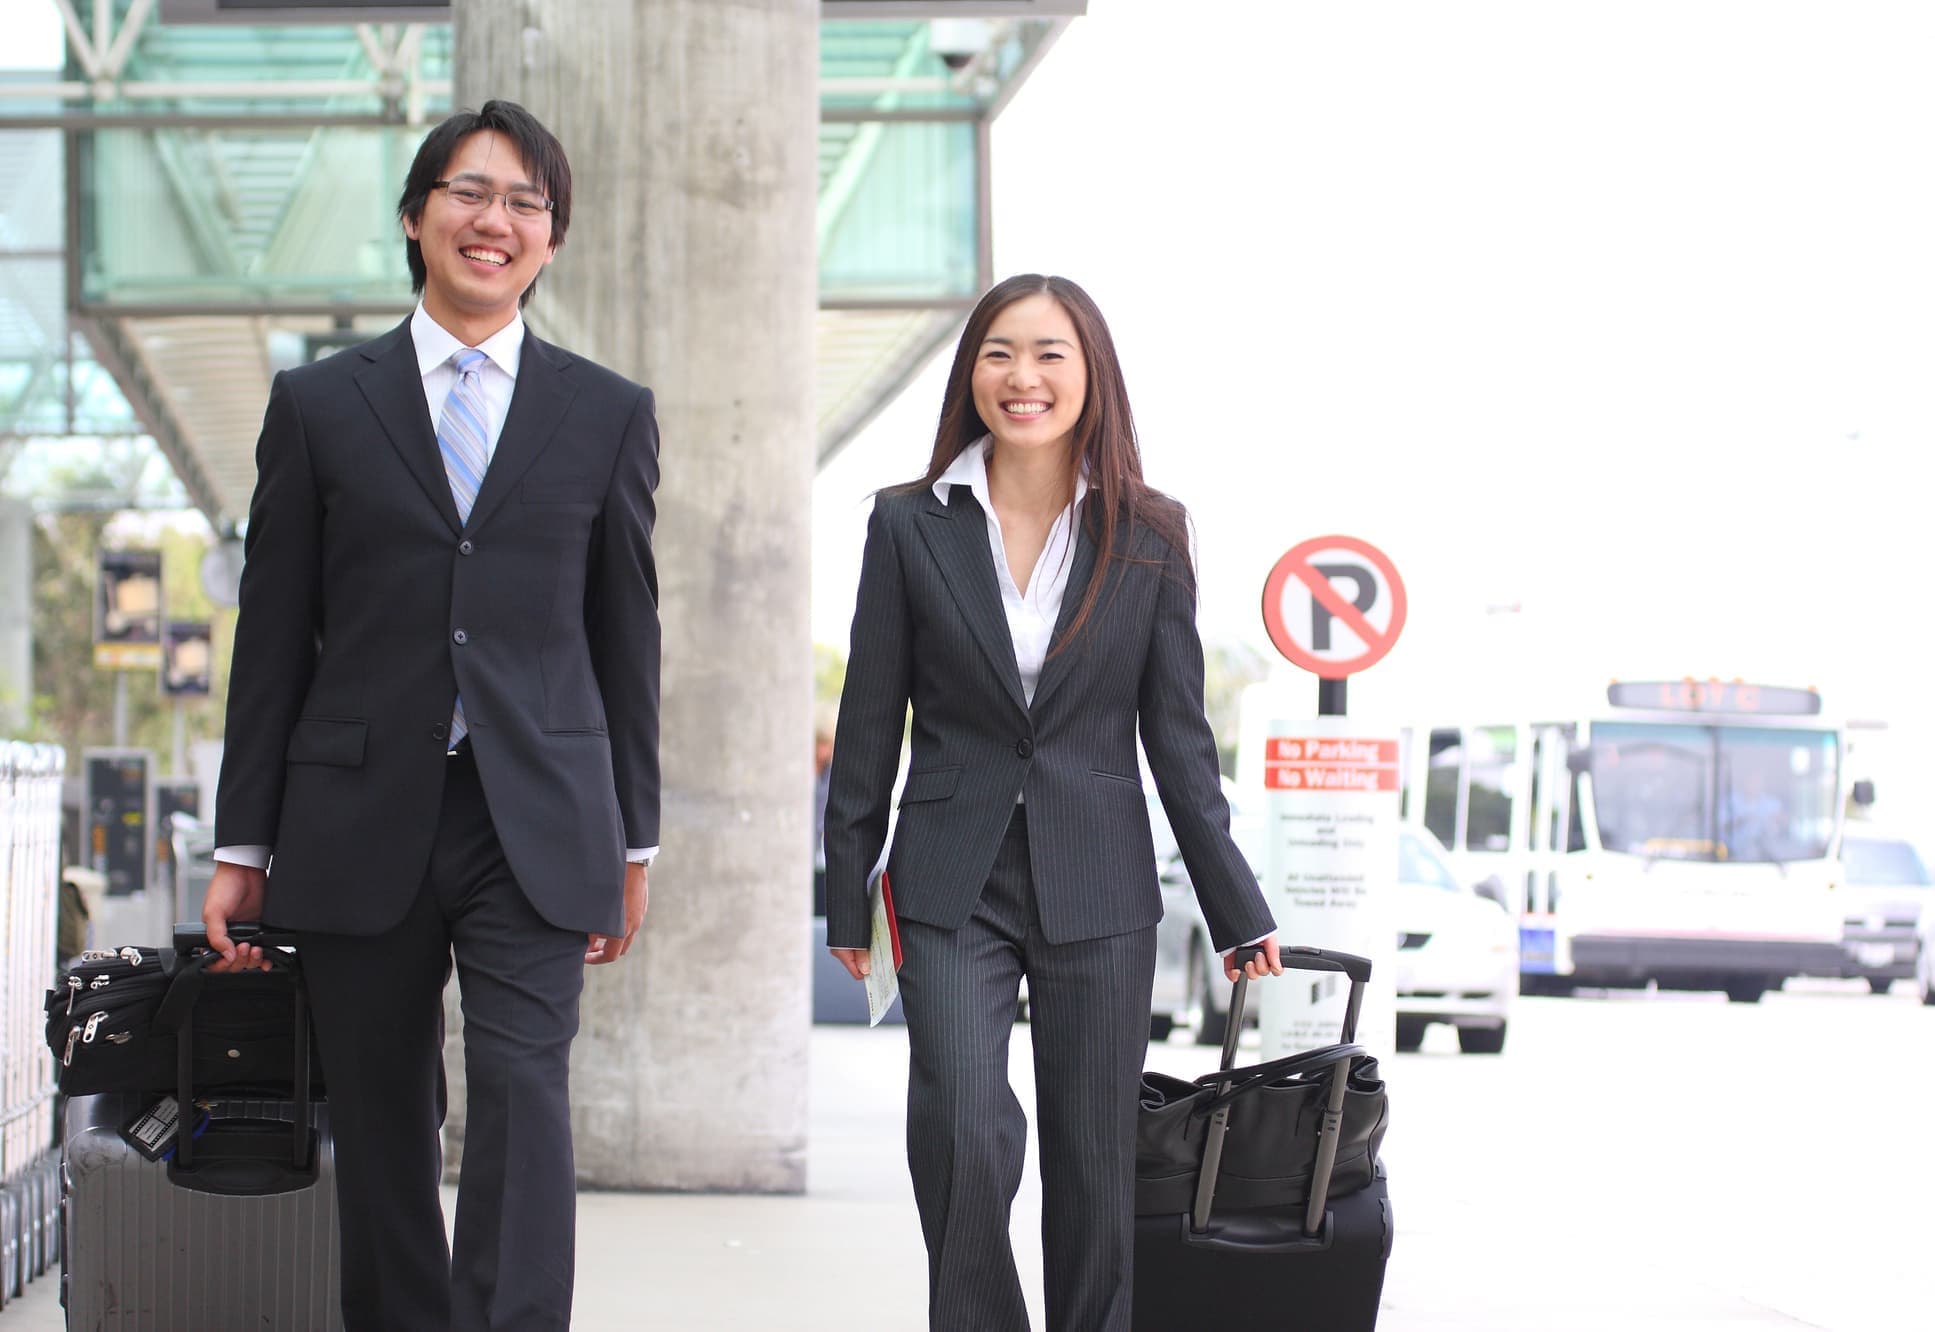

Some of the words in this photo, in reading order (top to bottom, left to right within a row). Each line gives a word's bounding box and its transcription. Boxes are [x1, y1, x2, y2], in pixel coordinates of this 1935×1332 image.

[1312, 564, 1377, 650] P
[1278, 739, 1301, 759] No
[1305, 739, 1379, 763] Parking
[1278, 768, 1301, 787] No
[1305, 768, 1379, 791] Waiting
